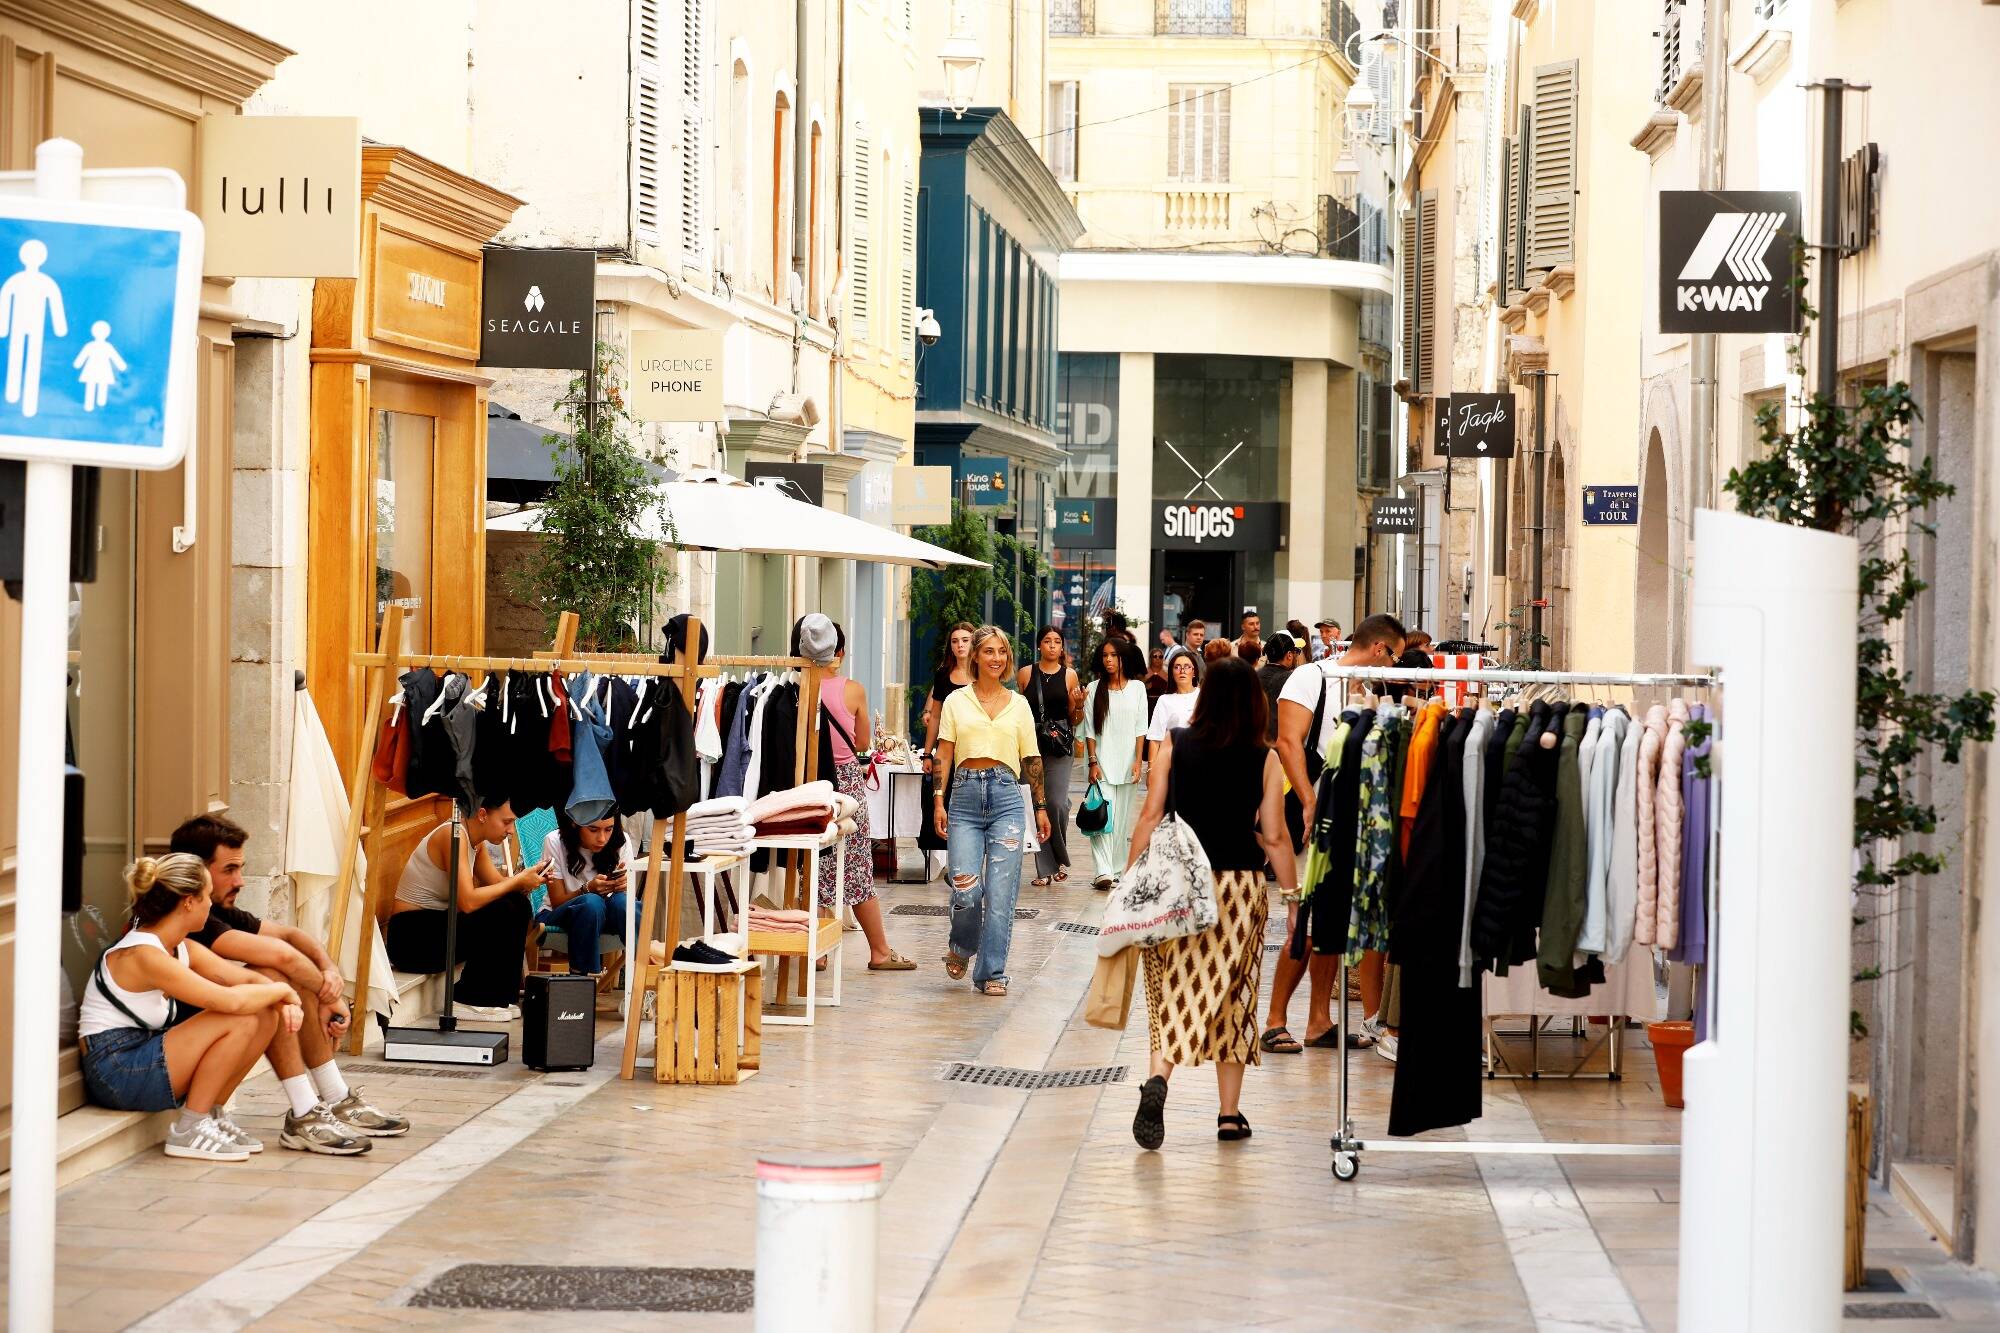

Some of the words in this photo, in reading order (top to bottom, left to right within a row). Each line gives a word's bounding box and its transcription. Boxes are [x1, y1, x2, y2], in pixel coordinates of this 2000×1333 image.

[488, 319, 581, 334] SEAGALE
[640, 358, 713, 372] URGENCE
[651, 380, 702, 393] PHONE
[966, 472, 989, 483] King
[1602, 490, 1637, 498] Traverse
[1610, 500, 1619, 509] de
[1622, 500, 1630, 509] la
[1377, 506, 1415, 515] JIMMY
[1599, 511, 1628, 521] TOUR
[1163, 505, 1235, 544] snipes
[1376, 517, 1416, 526] FAIRLY
[557, 1010, 585, 1020] Marshall
